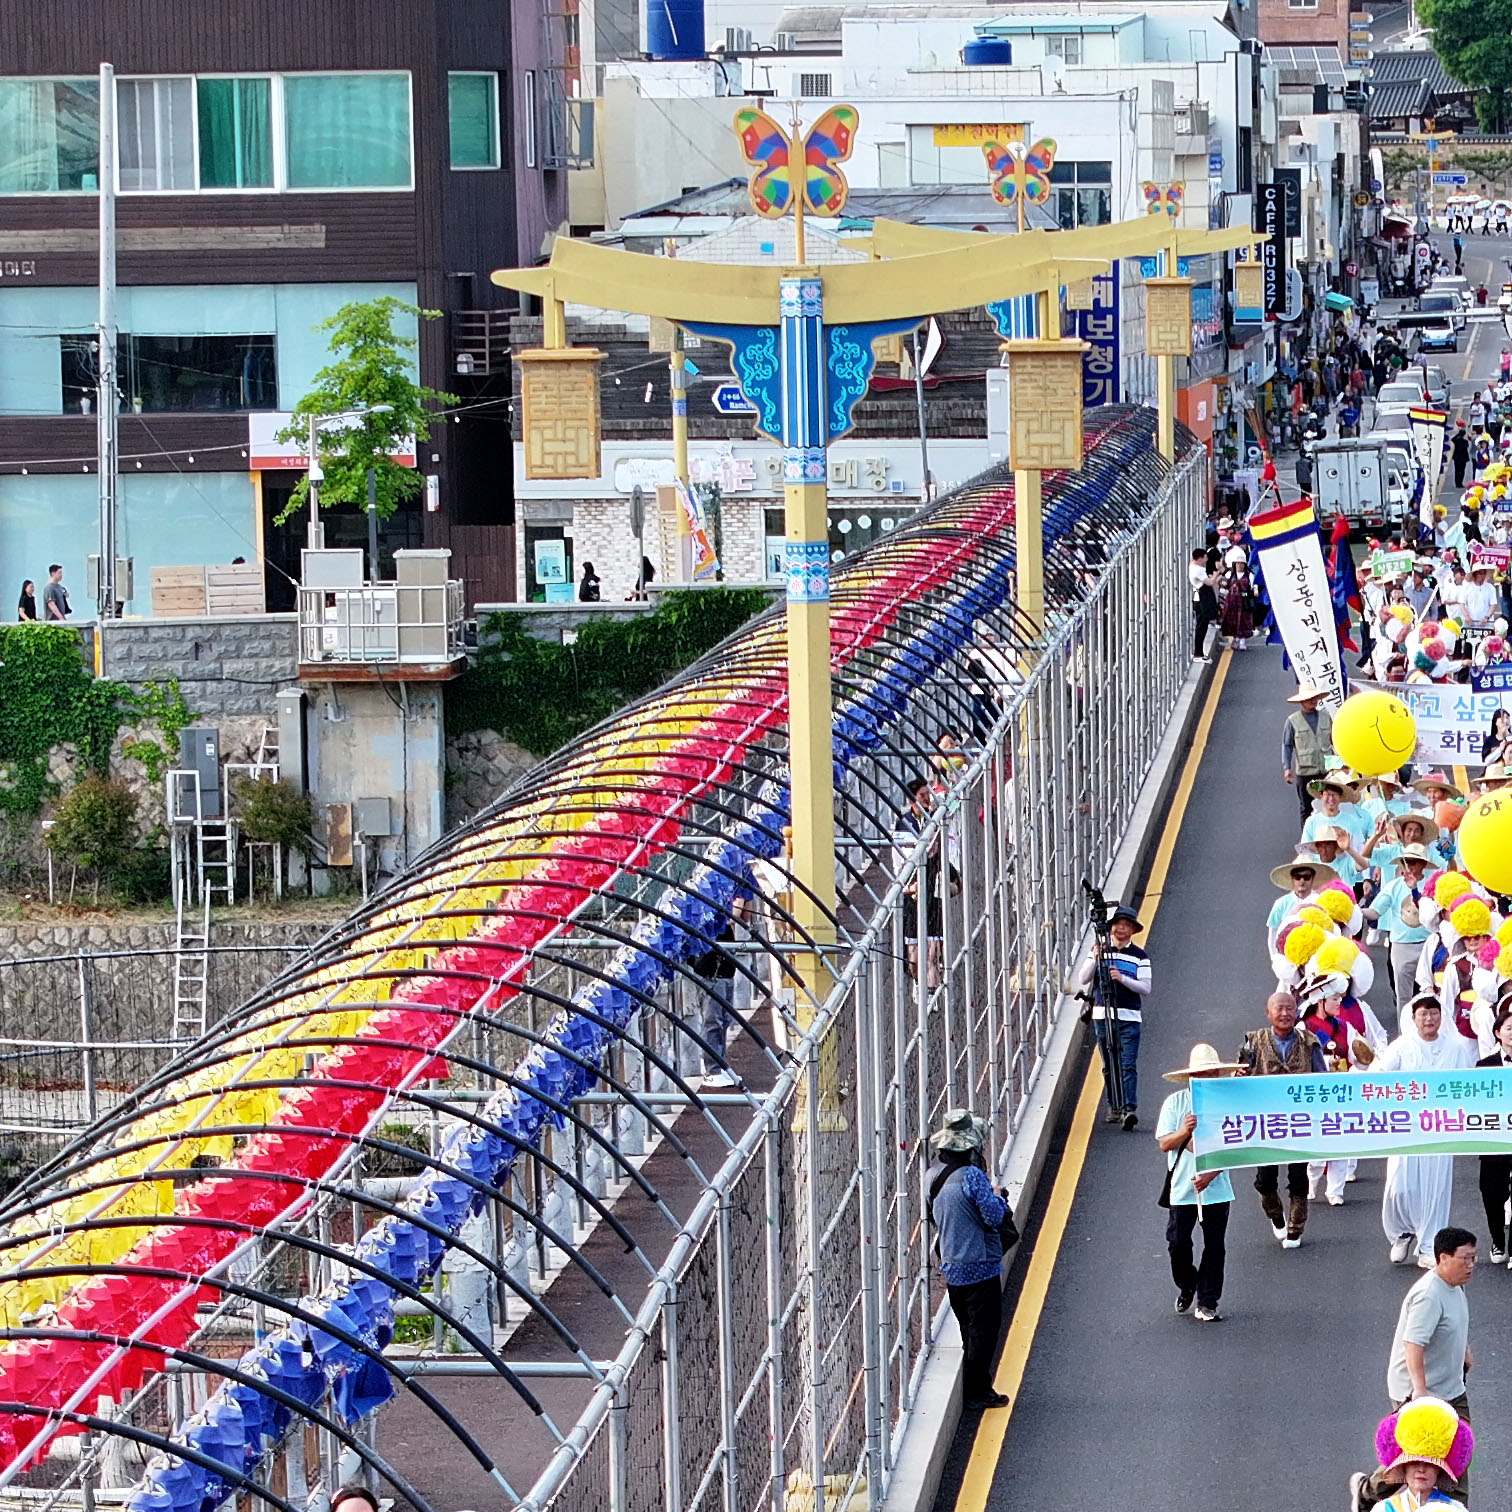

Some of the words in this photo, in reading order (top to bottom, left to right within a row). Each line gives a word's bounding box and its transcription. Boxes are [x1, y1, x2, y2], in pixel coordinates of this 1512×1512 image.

[1265, 188, 1278, 236] CAFE
[1084, 259, 1115, 404] 계보청기
[1453, 696, 1501, 722] 싶은
[1286, 1083, 1354, 1103] 일등농업!
[1361, 1080, 1428, 1102] 부자농촌!
[1435, 1079, 1504, 1099] 으뜸하남!
[1221, 1111, 1313, 1145] 살기좋은
[1319, 1110, 1412, 1136] 살고싶은
[1418, 1108, 1502, 1134] 하남으로
